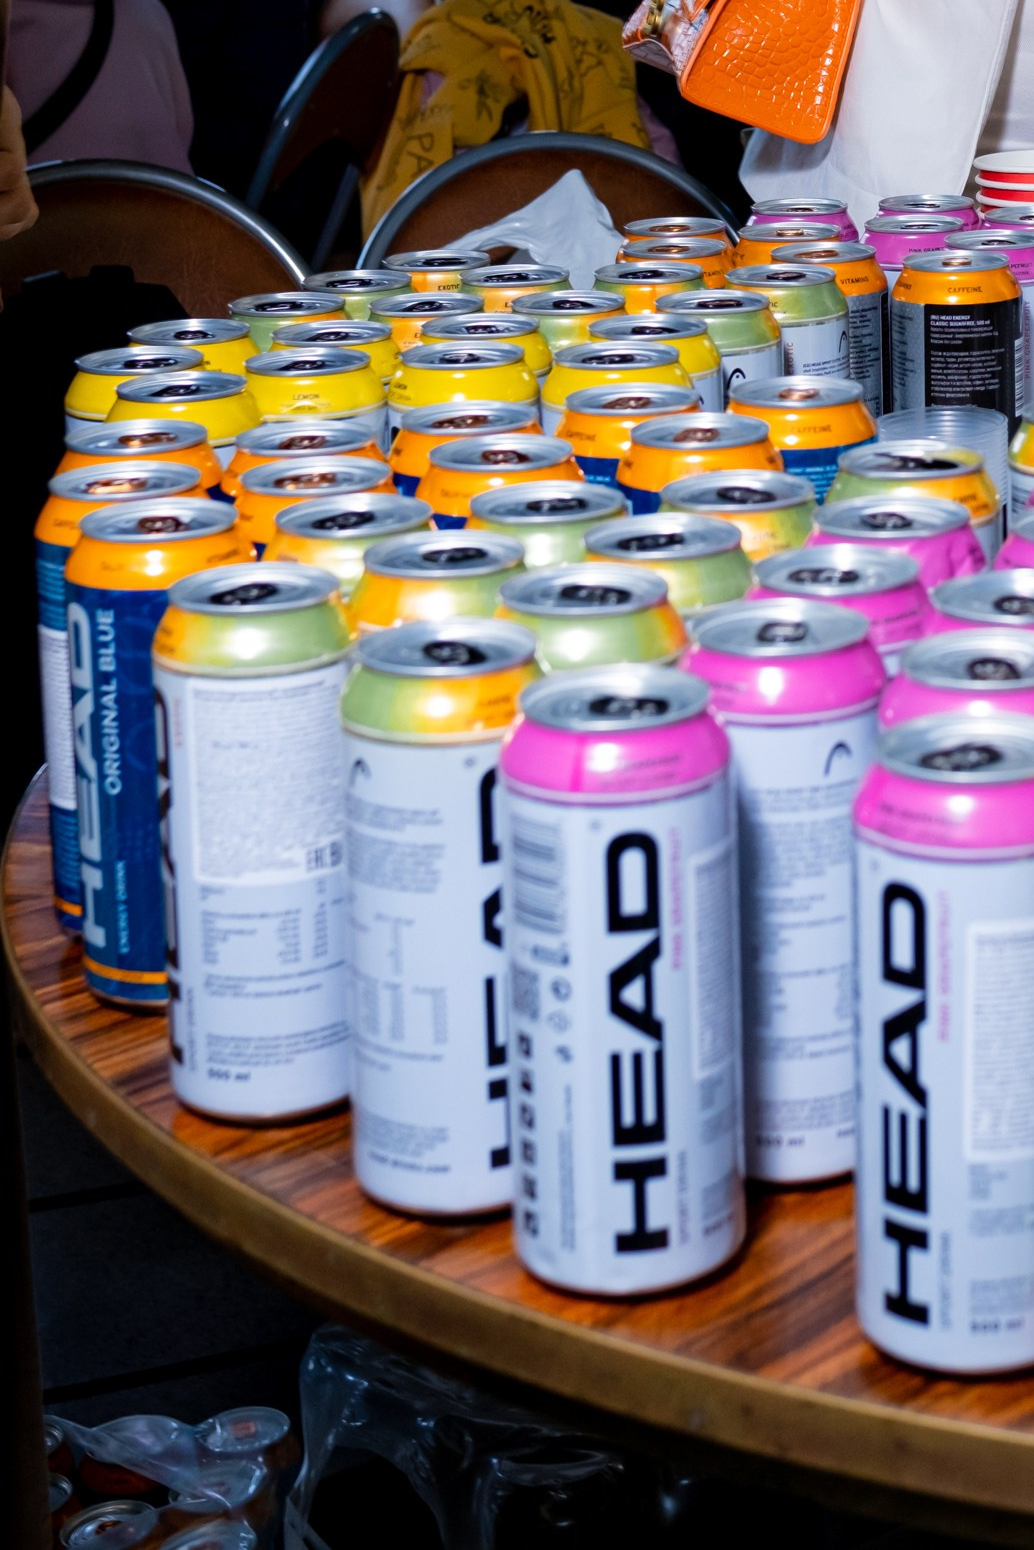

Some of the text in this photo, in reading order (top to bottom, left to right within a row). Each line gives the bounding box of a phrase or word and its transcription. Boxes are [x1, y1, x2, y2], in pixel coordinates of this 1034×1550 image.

[840, 276, 869, 285] VITAMINS
[947, 286, 983, 294] CAFFEINE
[791, 424, 832, 433] CAFFEINE
[67, 602, 106, 948] HEAD
[96, 609, 122, 796] ORIGINAL BLUE
[607, 831, 670, 1254] HEAD
[882, 881, 930, 1326] HEAD
